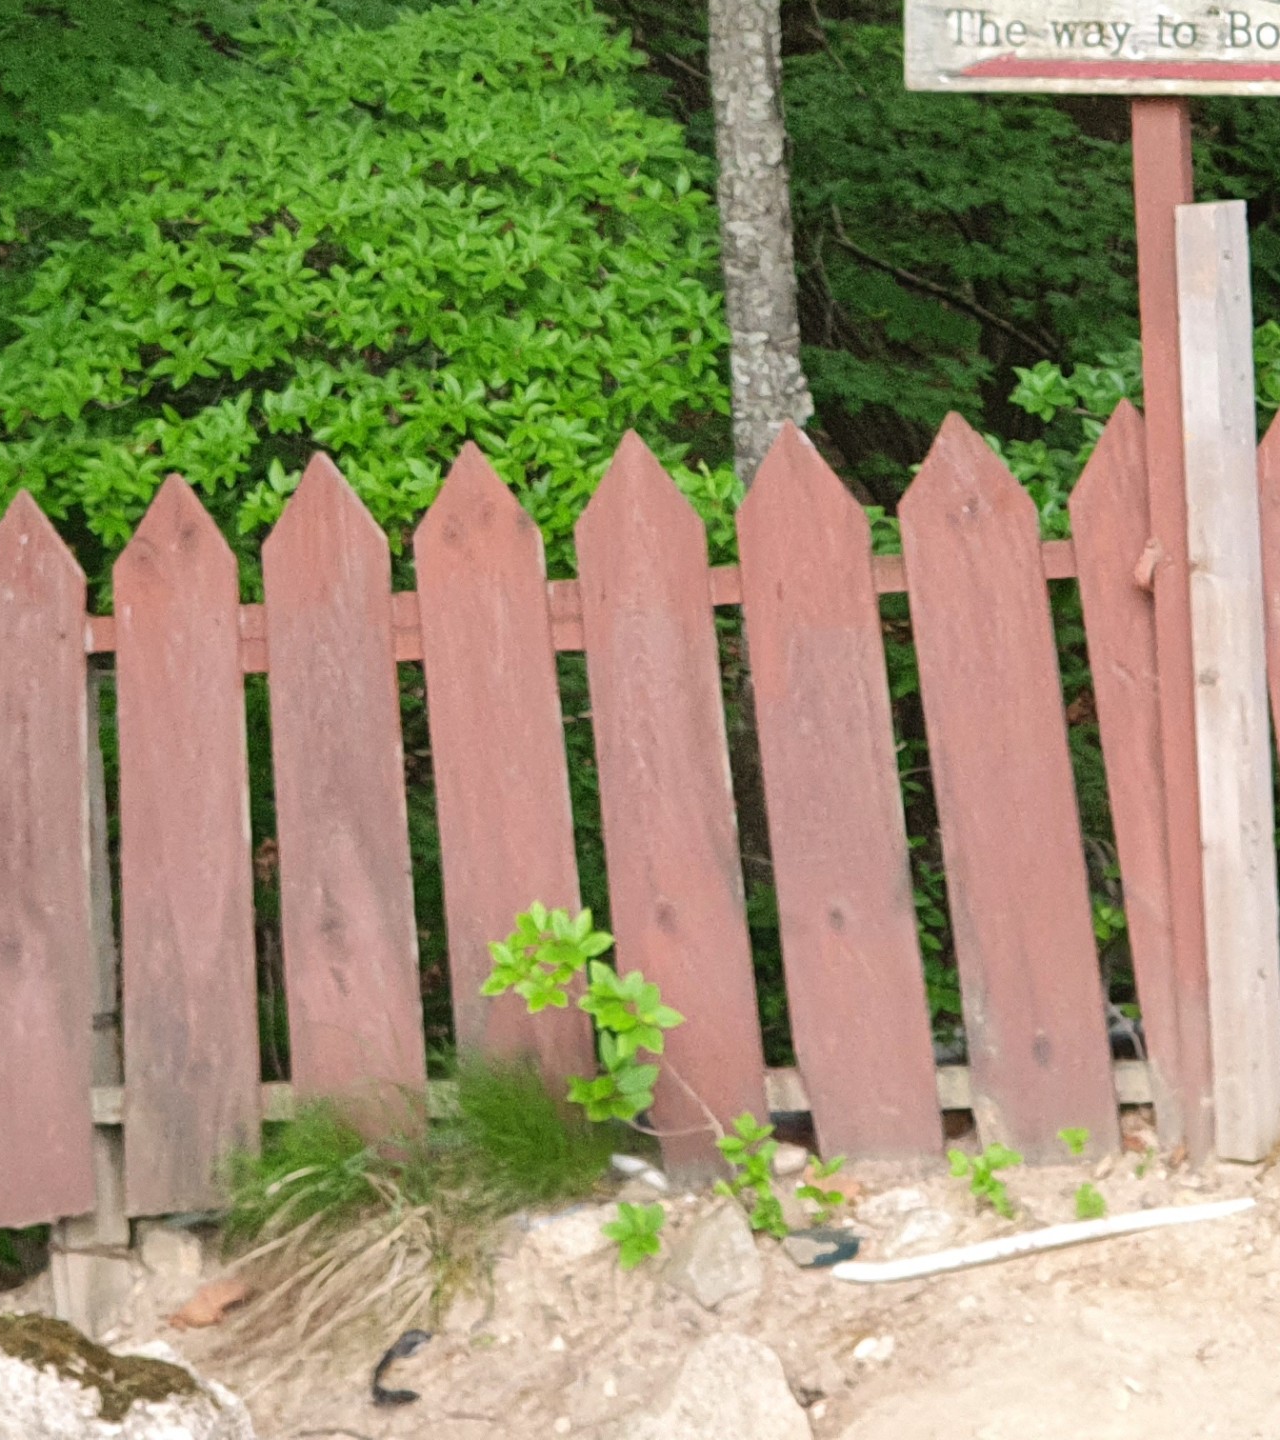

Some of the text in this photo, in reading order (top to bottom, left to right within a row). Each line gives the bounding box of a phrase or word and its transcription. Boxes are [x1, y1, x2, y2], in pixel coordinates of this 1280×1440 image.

[947, 7, 1027, 47] The
[1051, 20, 1132, 56] way
[1156, 14, 1197, 48] to
